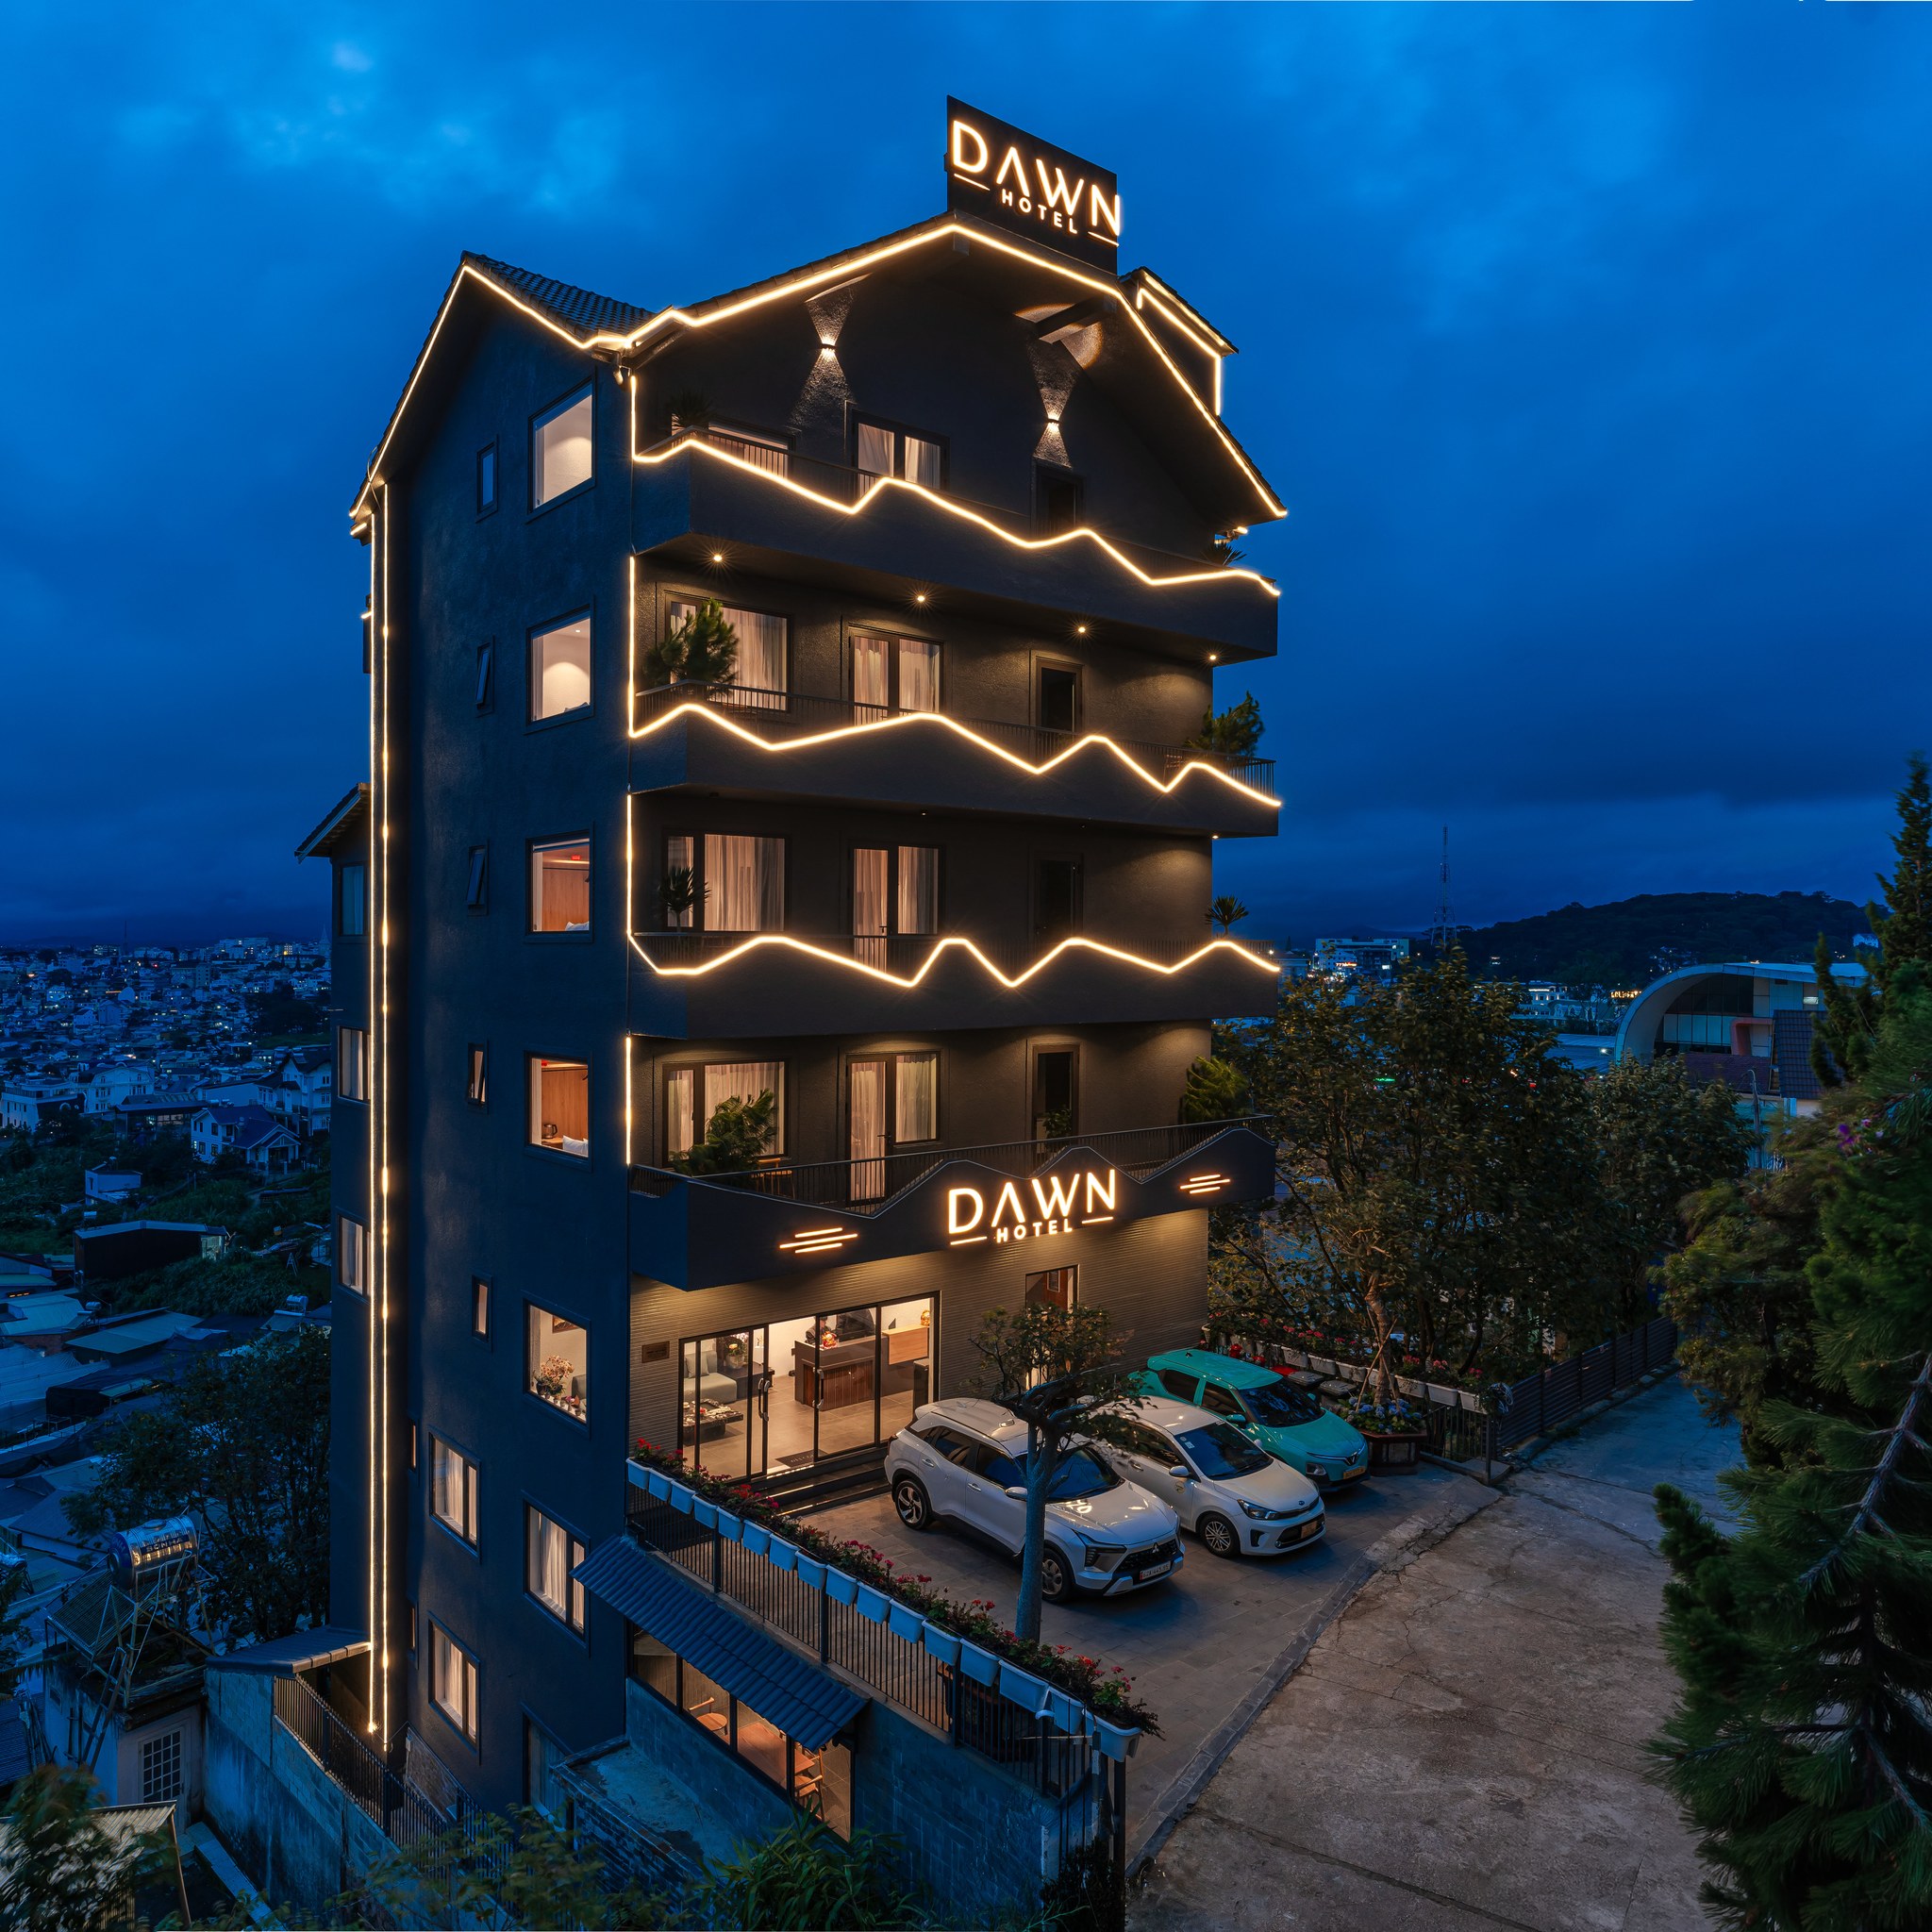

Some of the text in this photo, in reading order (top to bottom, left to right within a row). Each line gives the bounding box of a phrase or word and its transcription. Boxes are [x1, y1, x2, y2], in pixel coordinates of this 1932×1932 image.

[953, 120, 1121, 236] DAWN
[1002, 189, 1077, 234] HOTEL
[948, 1169, 1115, 1234] DAWN
[996, 1219, 1073, 1242] HOTEL
